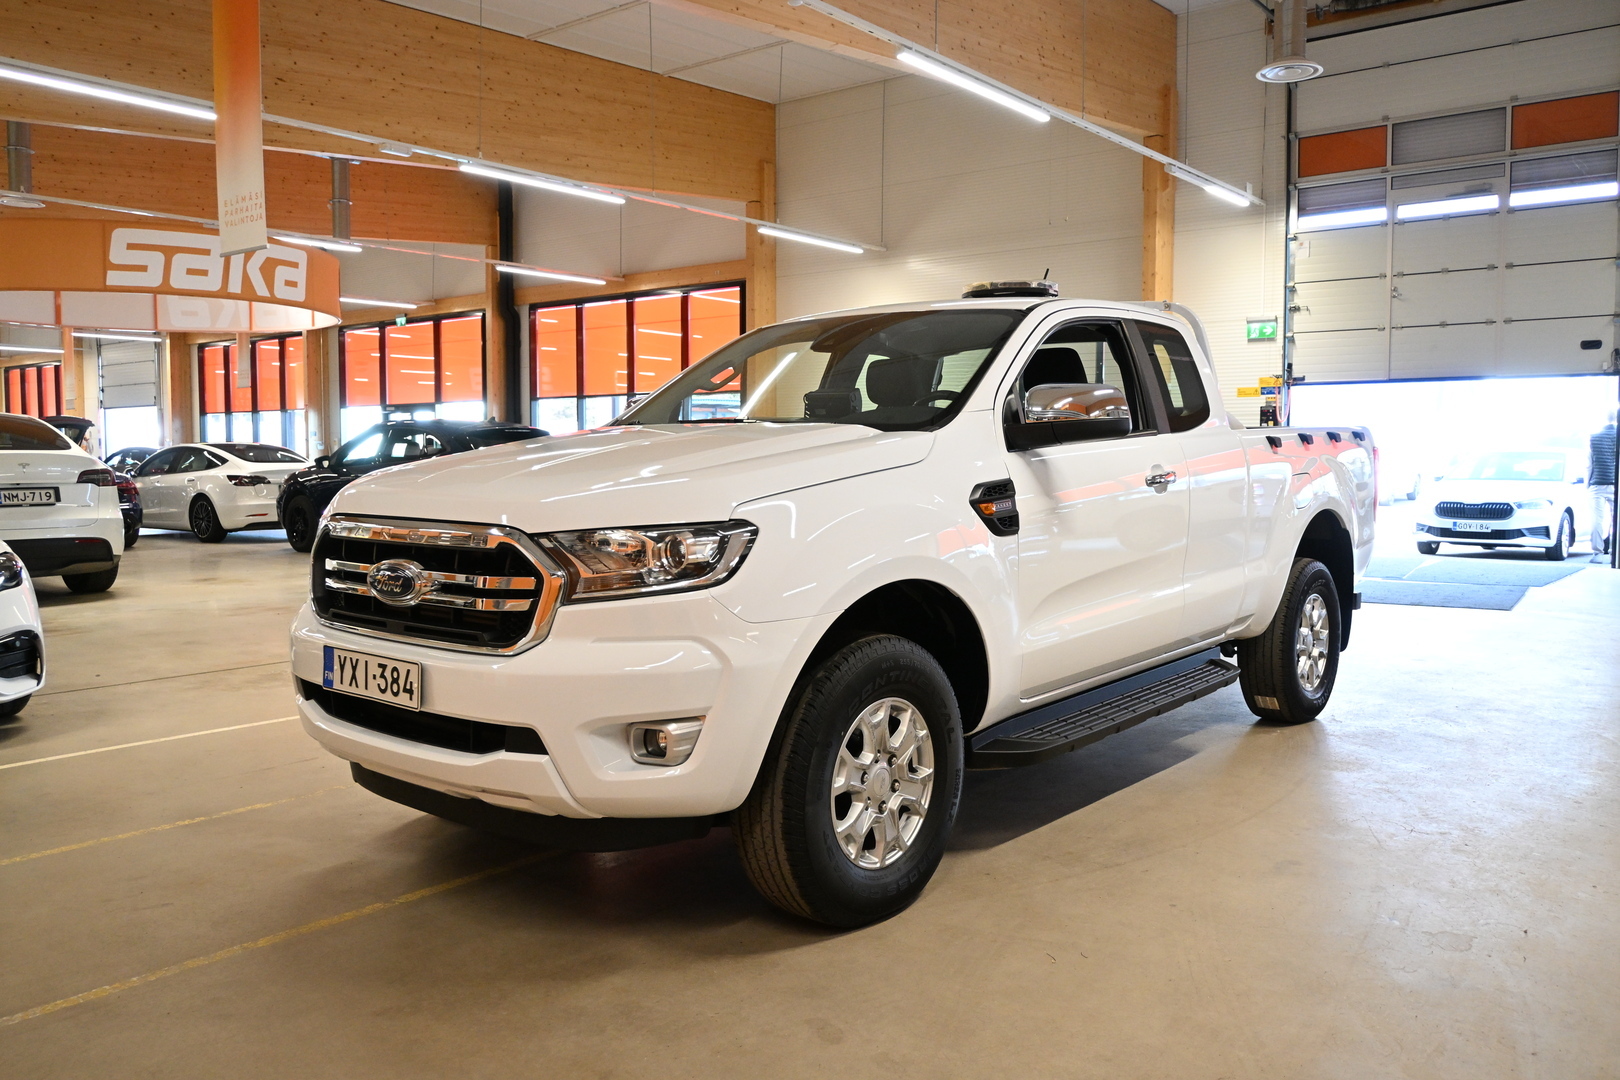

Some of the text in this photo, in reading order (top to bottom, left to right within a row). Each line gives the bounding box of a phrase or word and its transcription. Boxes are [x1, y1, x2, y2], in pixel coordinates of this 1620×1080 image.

[223, 190, 263, 208] ELÄMÄSI
[224, 201, 263, 217] PARHAITA
[224, 212, 264, 228] VALINTOJA
[3, 491, 52, 502] NMJ-719
[1457, 522, 1490, 531] GOV-184
[374, 574, 404, 593] Ford
[324, 670, 334, 681] FIN
[337, 654, 415, 702] YXI-384
